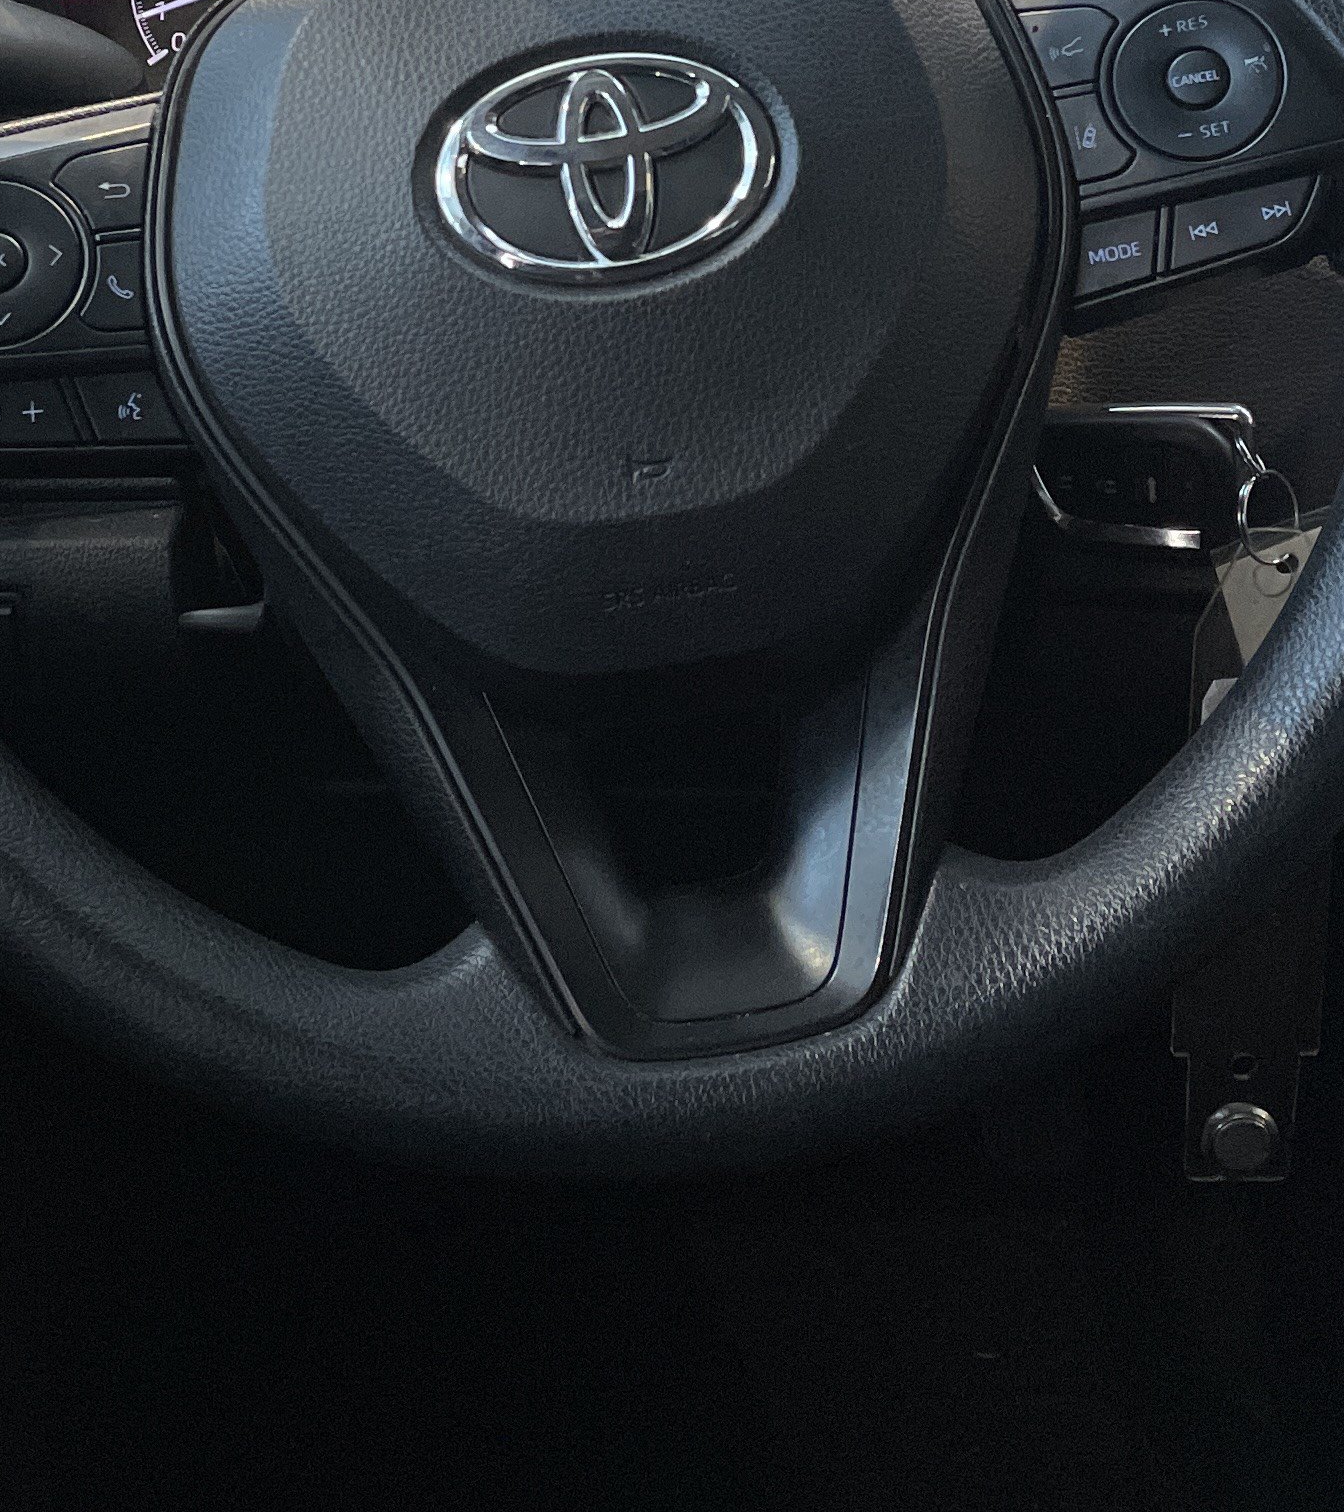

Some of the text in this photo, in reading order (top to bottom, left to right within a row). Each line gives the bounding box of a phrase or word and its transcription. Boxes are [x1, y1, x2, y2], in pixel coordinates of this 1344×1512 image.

[1176, 15, 1208, 34] RES
[1172, 69, 1220, 88] CANCEL
[1199, 120, 1230, 138] SET
[1088, 241, 1142, 265] MODE
